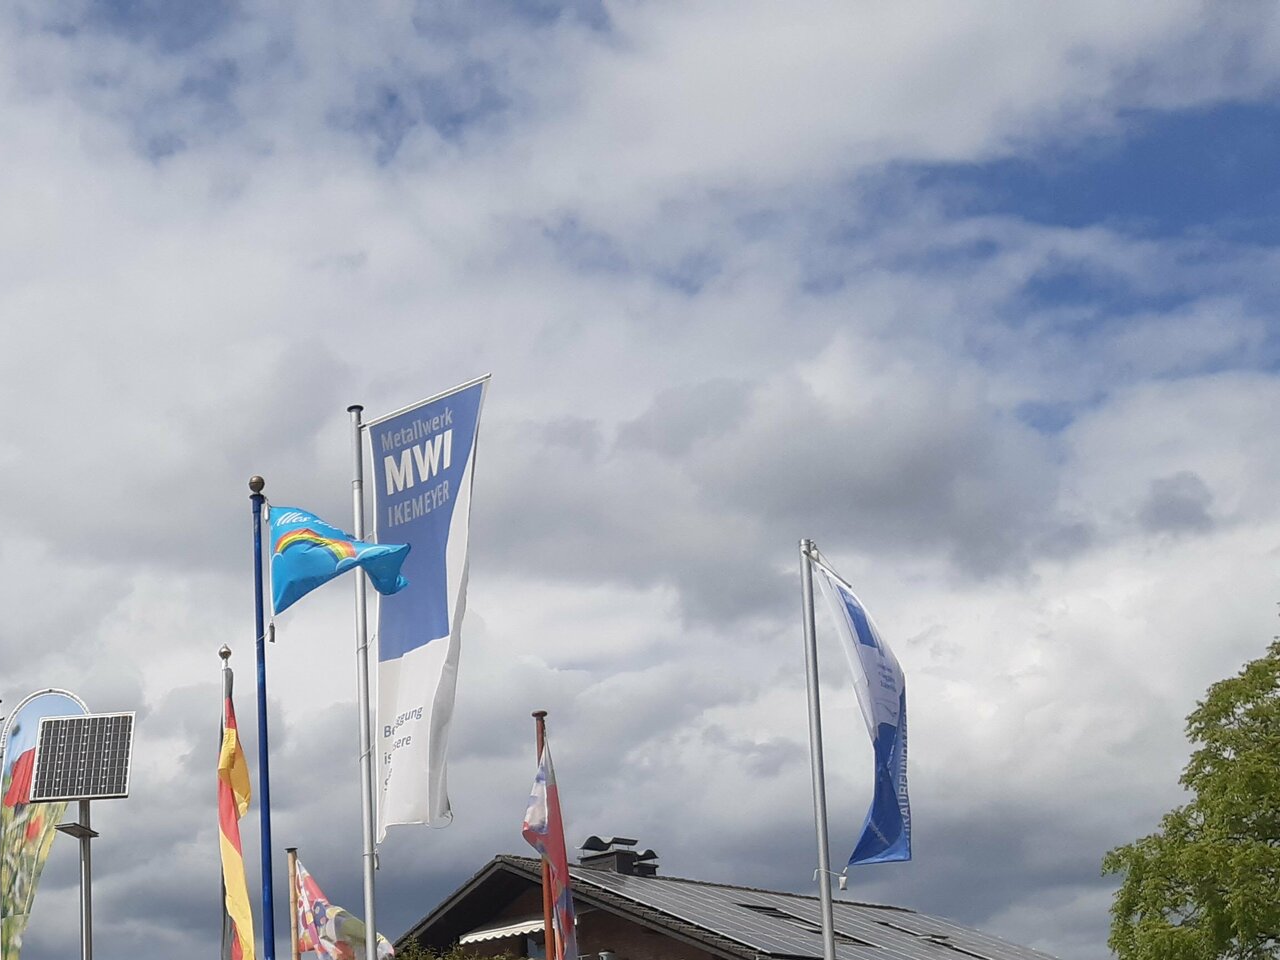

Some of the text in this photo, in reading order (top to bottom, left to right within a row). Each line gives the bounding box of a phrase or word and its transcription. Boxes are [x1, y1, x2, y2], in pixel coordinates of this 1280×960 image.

[380, 406, 454, 452] Metallwerk
[383, 428, 454, 496] MWI
[387, 479, 451, 528] IKEMEYER
